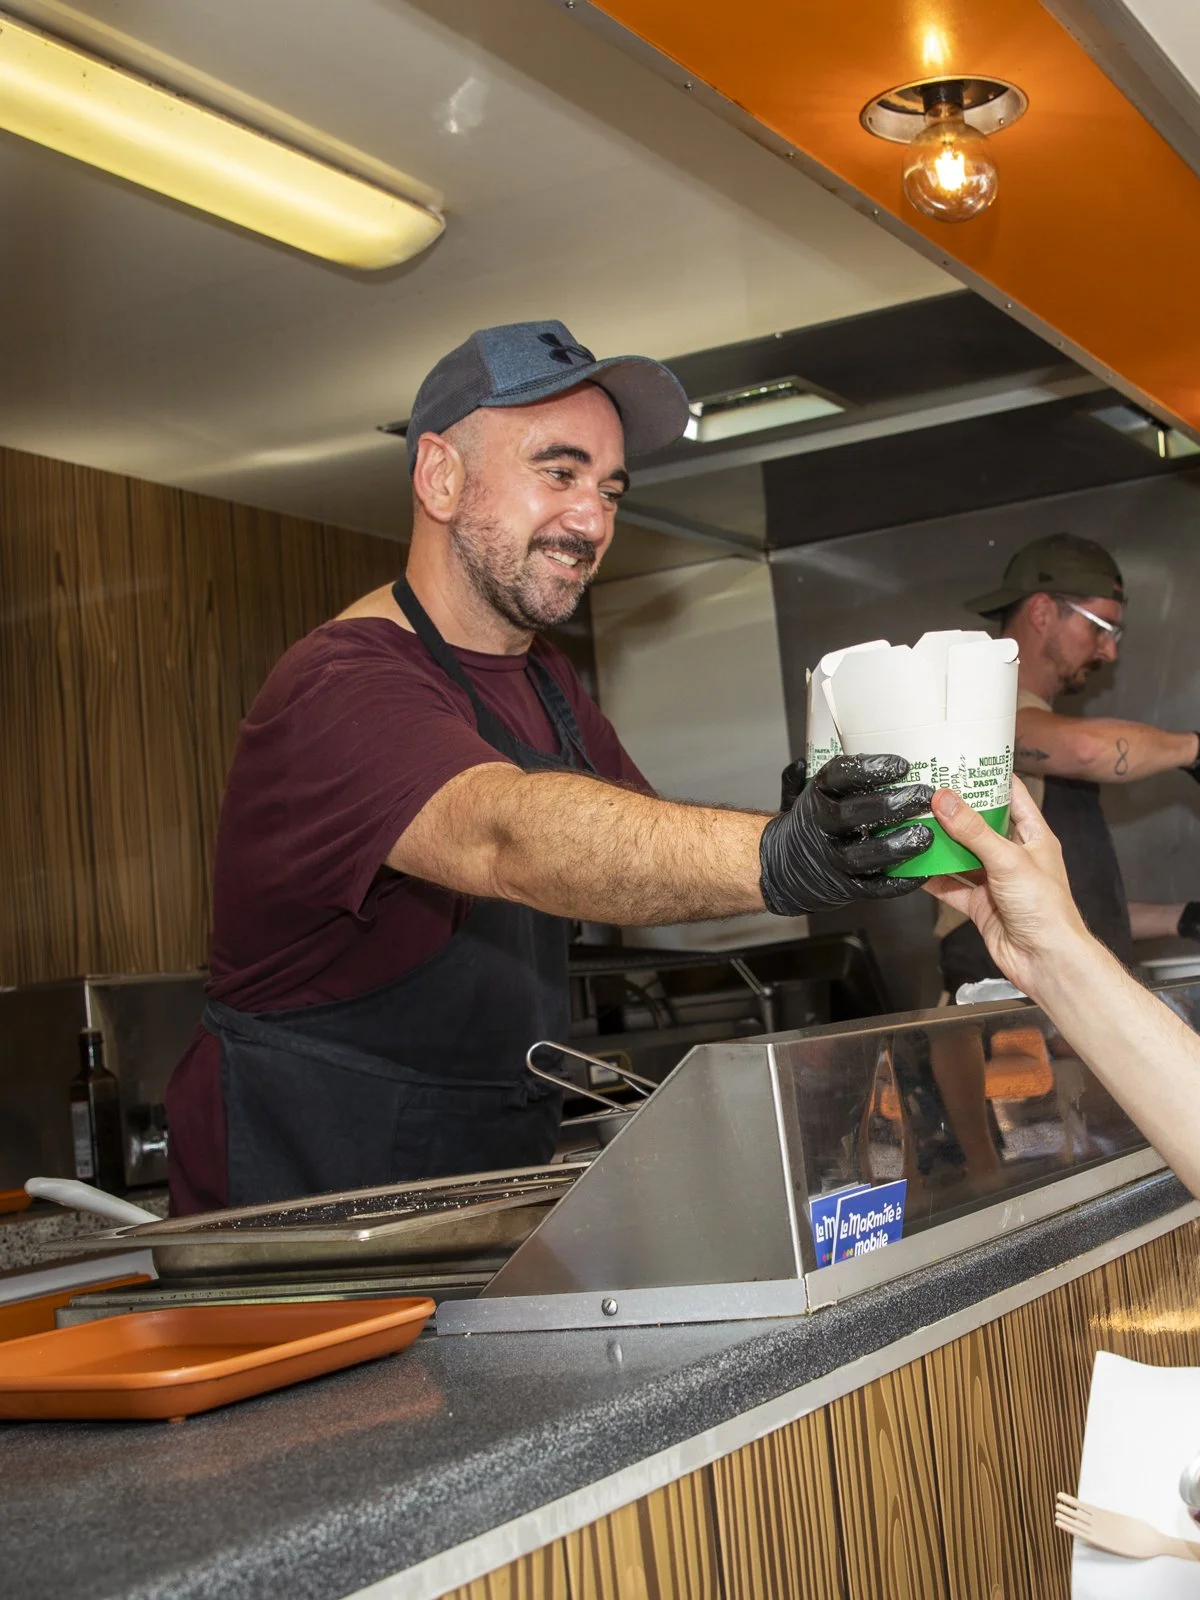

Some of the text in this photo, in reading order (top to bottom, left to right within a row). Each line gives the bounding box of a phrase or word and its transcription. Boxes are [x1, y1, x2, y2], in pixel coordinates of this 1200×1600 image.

[909, 761, 929, 770] otto
[979, 755, 1005, 766] NOODLES
[939, 766, 950, 788] OTTO
[968, 767, 1003, 778] Risotto
[951, 773, 961, 795] UPPA
[973, 778, 998, 787] PASTA
[963, 790, 989, 799] SOUPE
[971, 800, 988, 808] otto
[840, 1219, 848, 1239] La
[854, 1229, 888, 1257] mobile
